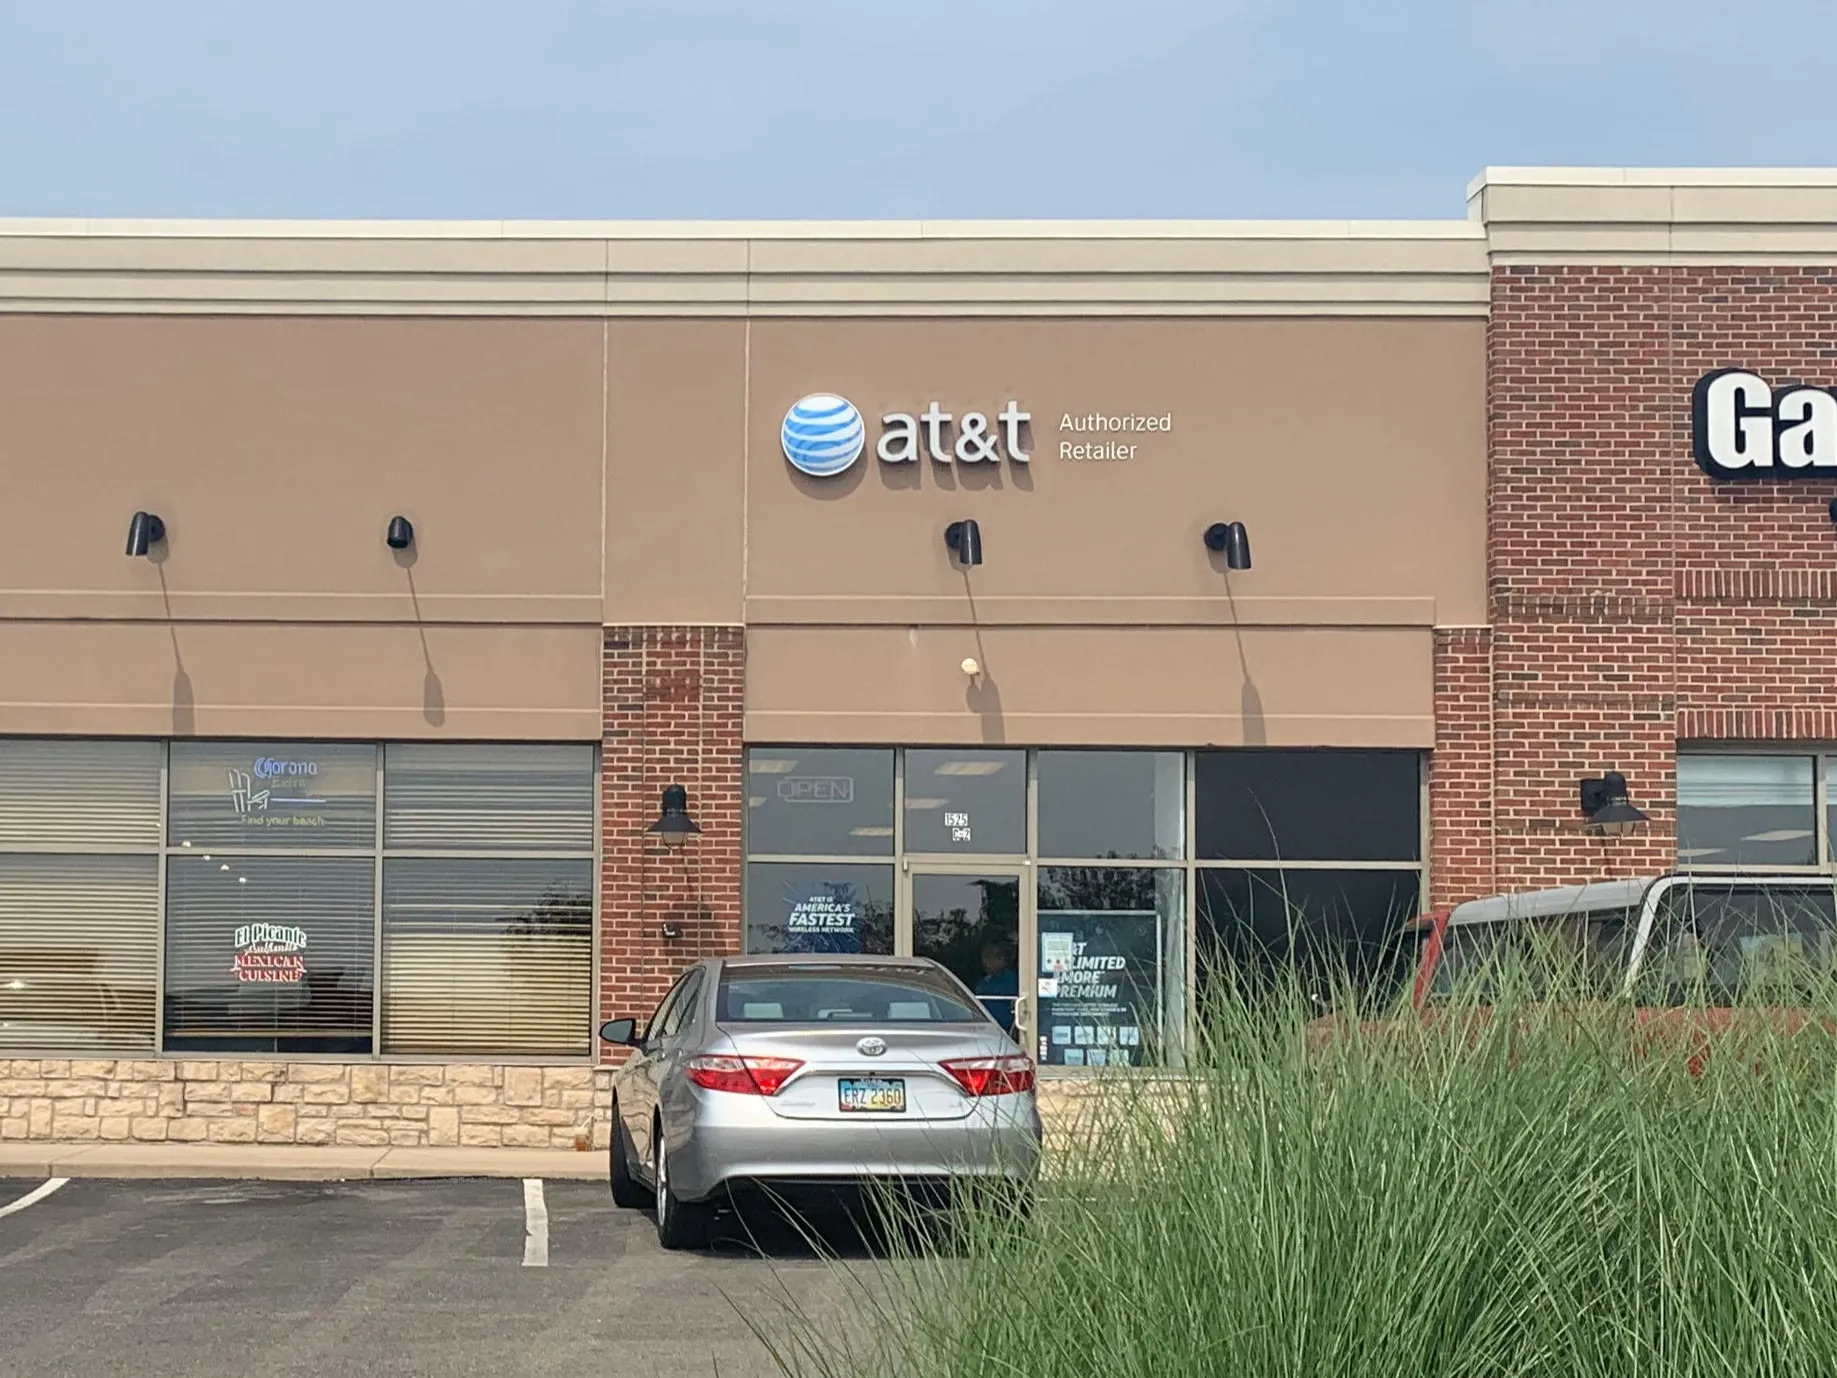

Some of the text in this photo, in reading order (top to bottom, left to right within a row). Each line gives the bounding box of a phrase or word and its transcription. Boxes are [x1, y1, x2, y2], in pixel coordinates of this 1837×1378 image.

[1058, 411, 1172, 434] Authorized
[876, 399, 1032, 464] at&t
[1058, 441, 1138, 461] Retailer
[254, 756, 318, 779] Corona
[776, 780, 849, 798] OPEN
[265, 816, 289, 827] your
[945, 812, 968, 826] 1525
[794, 902, 851, 913] AMERICA'S
[789, 912, 856, 926] FASTEST
[232, 954, 304, 969] MEXICAN
[239, 969, 303, 982] CUISINE
